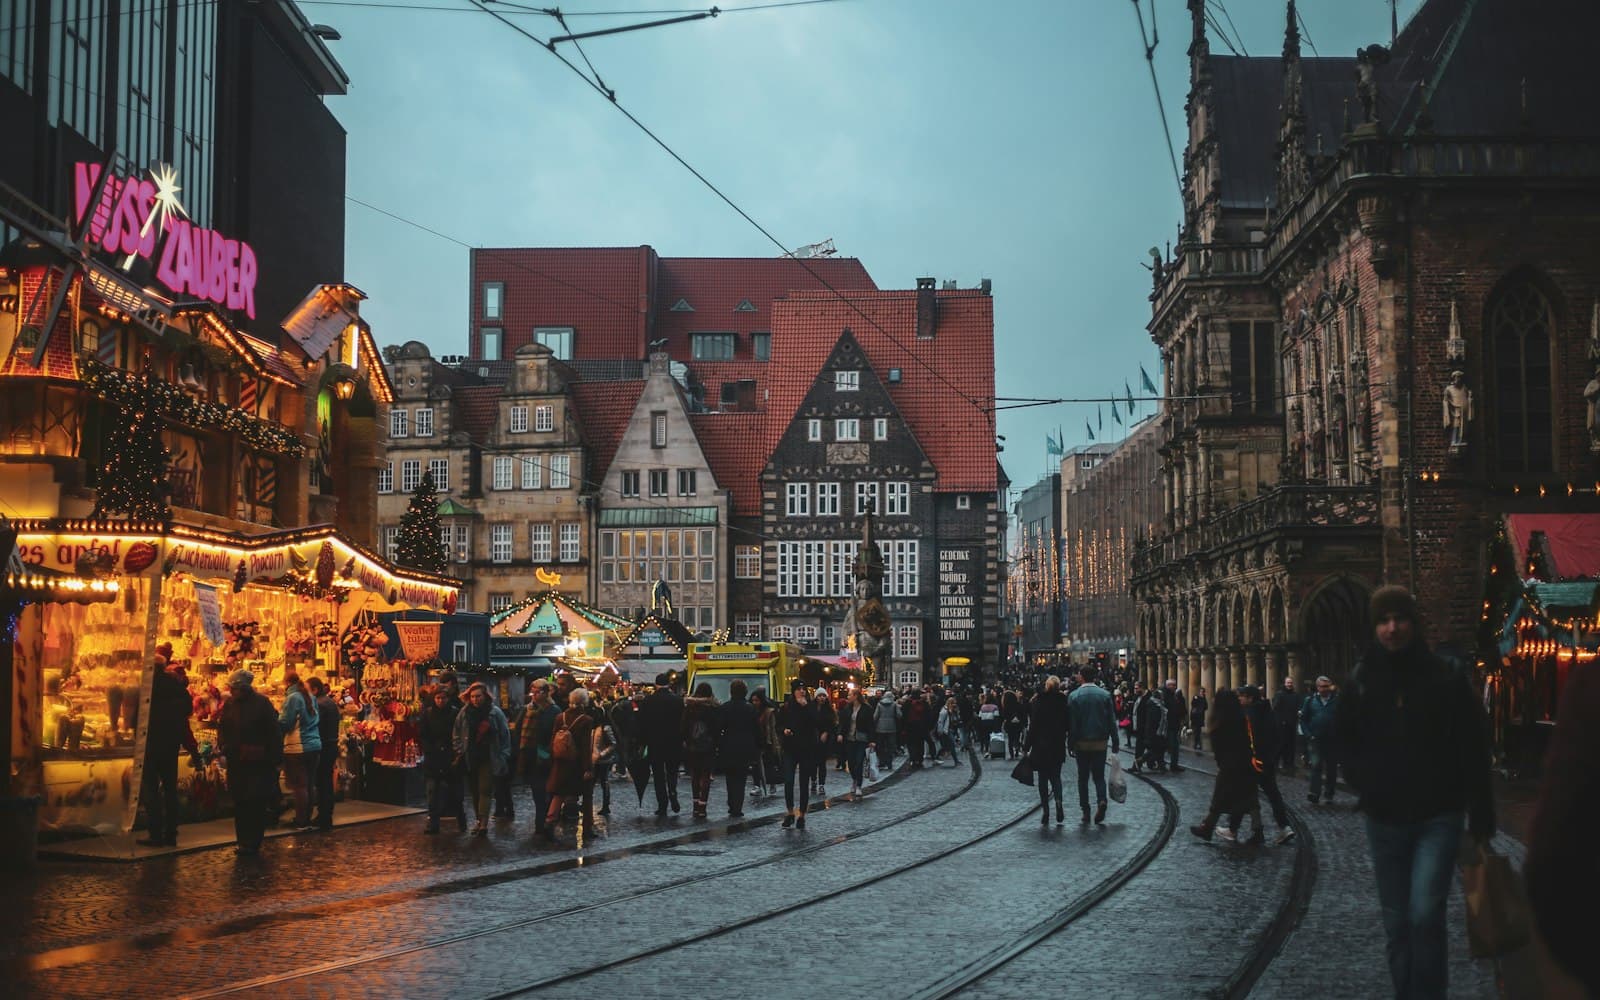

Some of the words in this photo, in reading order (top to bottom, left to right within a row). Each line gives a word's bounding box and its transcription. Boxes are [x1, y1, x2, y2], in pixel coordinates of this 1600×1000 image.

[156, 213, 258, 320] ZAUBER
[175, 544, 231, 573] Zuckerwolle
[940, 550, 970, 560] GEDENKE
[250, 551, 284, 577] Popcorn
[940, 561, 954, 571] DER
[940, 585, 951, 595] DIE
[952, 585, 966, 595] AS
[940, 596, 975, 606] SCHICKSAL
[940, 607, 970, 617] UNSERER
[940, 618, 975, 628] TRENNUNG
[940, 630, 965, 640] TRAGEN
[495, 642, 532, 650] Souvenirs
